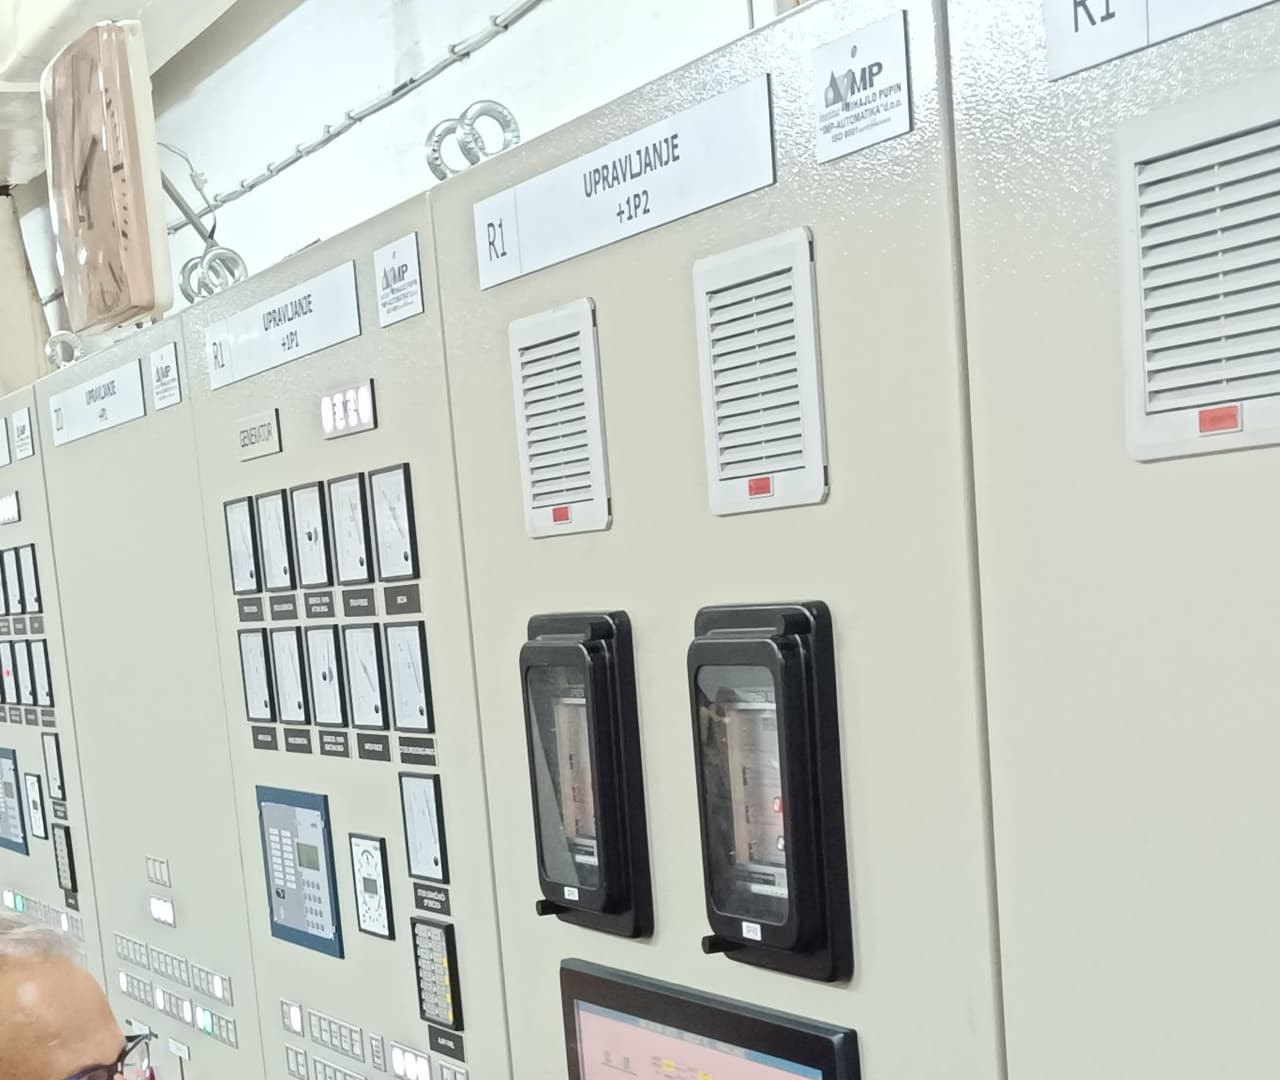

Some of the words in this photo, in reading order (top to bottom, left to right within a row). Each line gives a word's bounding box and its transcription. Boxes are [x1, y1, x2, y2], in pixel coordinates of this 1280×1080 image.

[878, 81, 902, 100] PUPIN
[583, 133, 681, 199] UPRAVLJANJE
[616, 189, 651, 224] +1P2
[487, 217, 508, 262] R1
[262, 293, 313, 332] UPRAVLJANJE
[212, 340, 225, 370] R1
